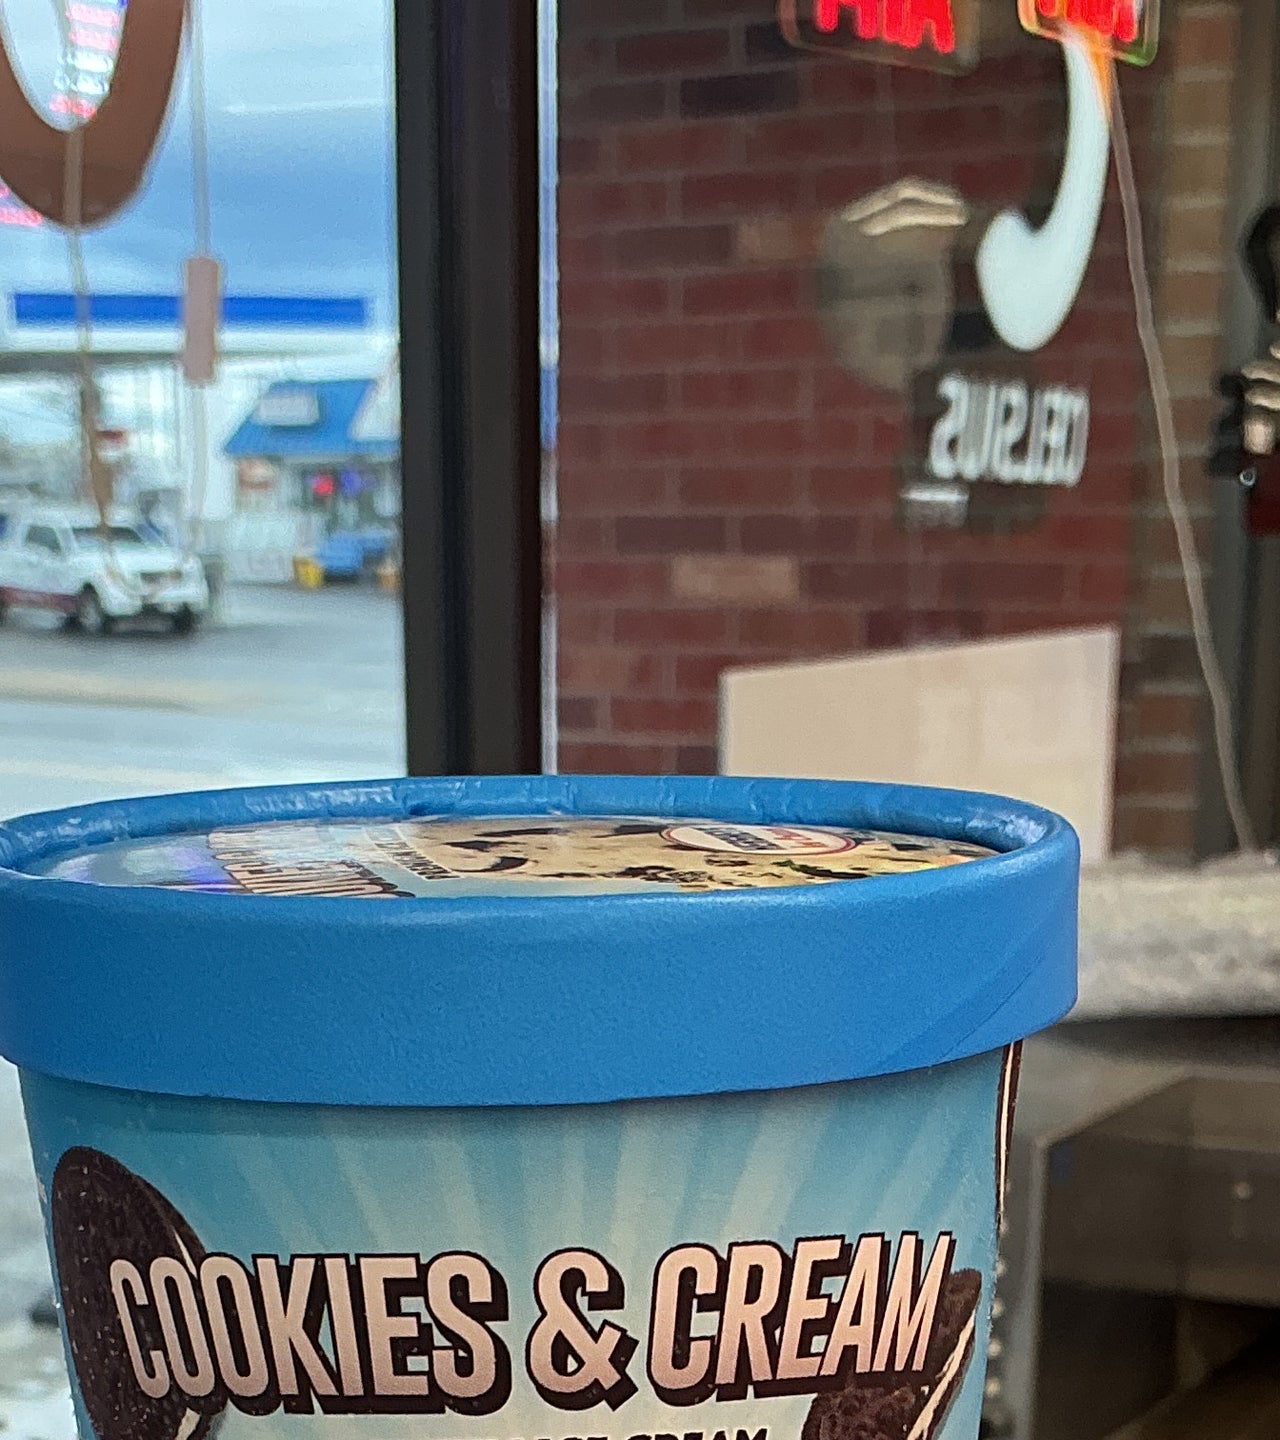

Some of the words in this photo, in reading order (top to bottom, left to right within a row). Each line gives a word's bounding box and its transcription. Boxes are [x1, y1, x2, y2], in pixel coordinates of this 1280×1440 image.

[108, 1250, 512, 1416] COOKIES
[521, 1247, 639, 1412] &
[647, 1231, 958, 1402] CREAM
